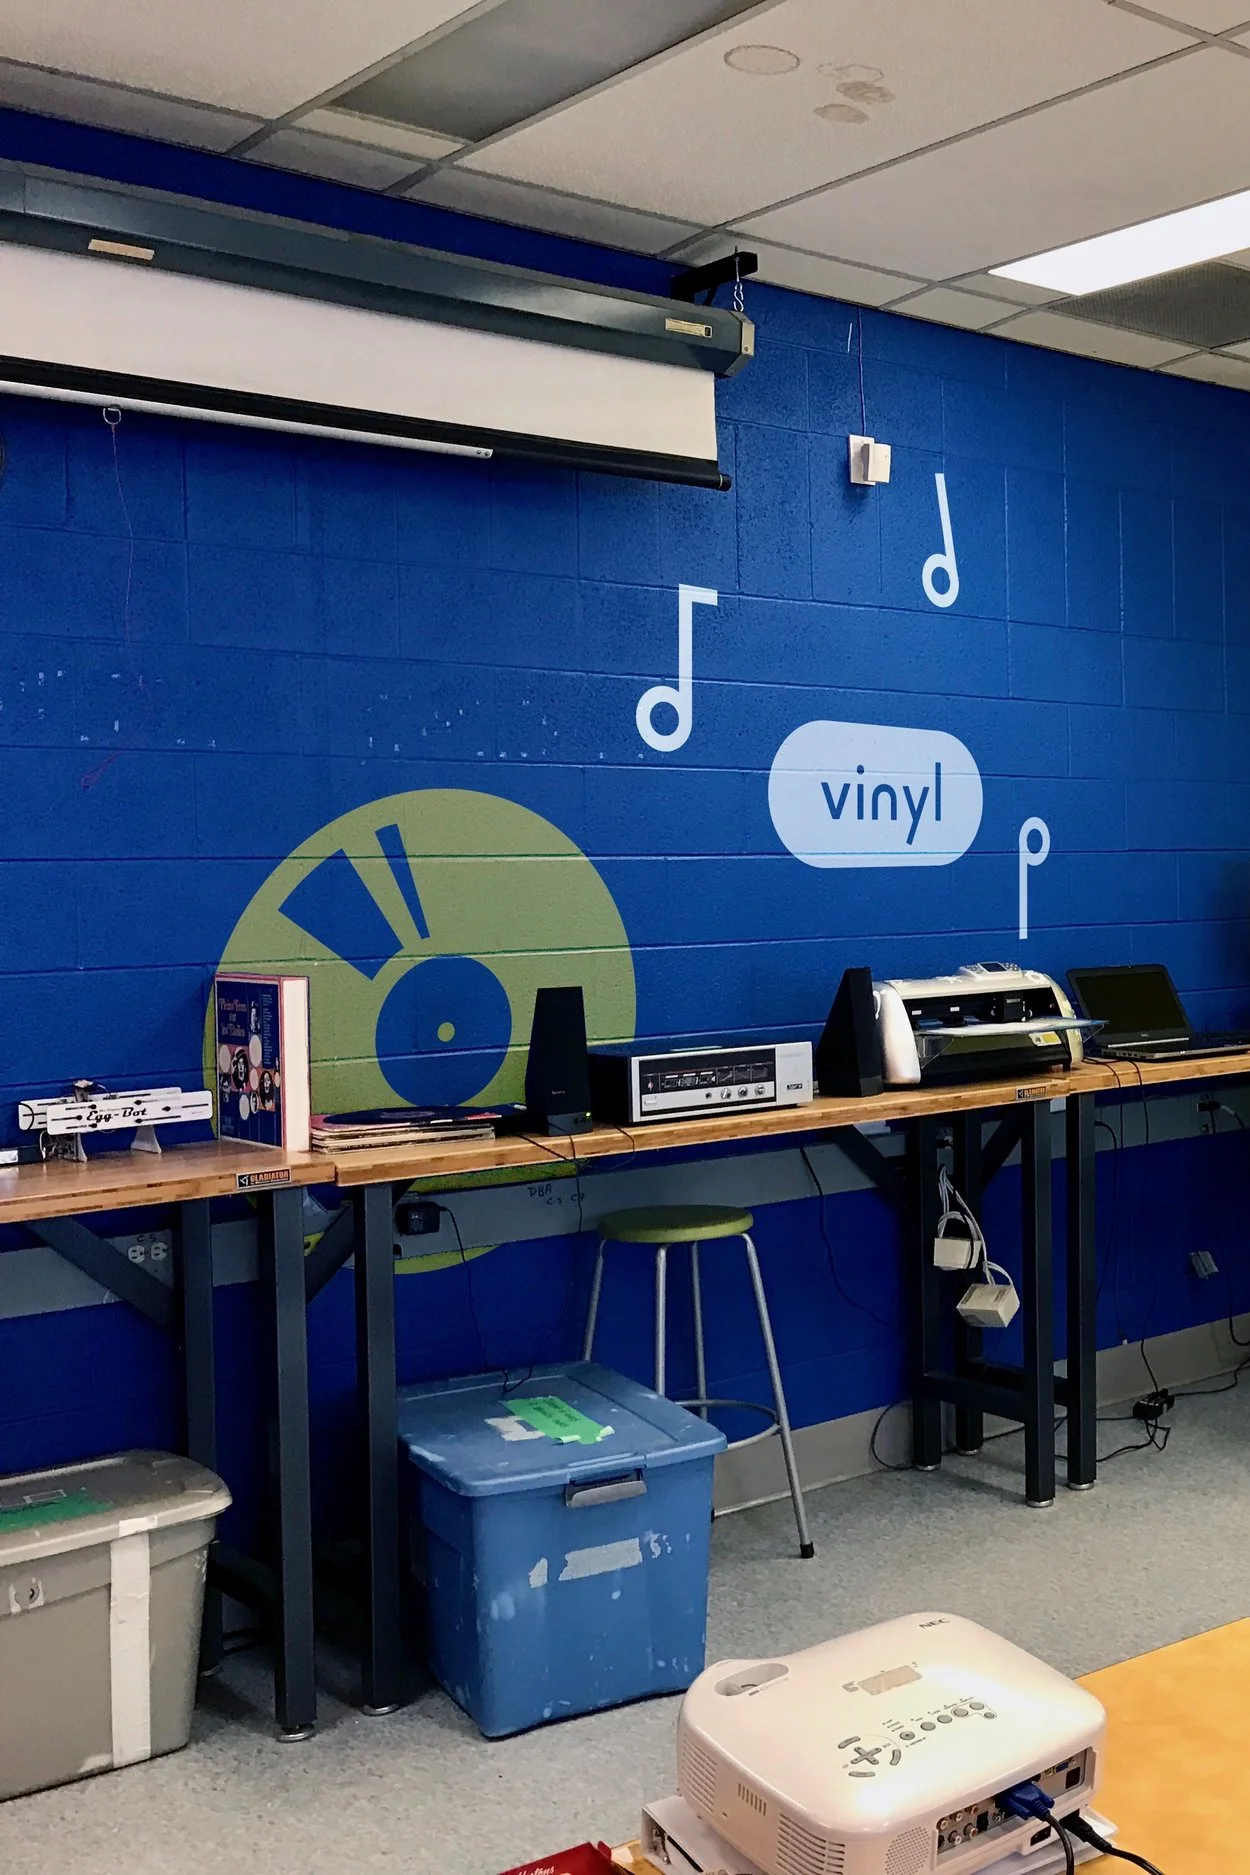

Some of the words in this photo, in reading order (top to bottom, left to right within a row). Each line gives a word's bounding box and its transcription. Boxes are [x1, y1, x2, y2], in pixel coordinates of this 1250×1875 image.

[820, 761, 942, 846] vinyl
[86, 1106, 148, 1124] Egg-Bot
[250, 1170, 289, 1183] GLADIATOR
[918, 1617, 951, 1629] NEC
